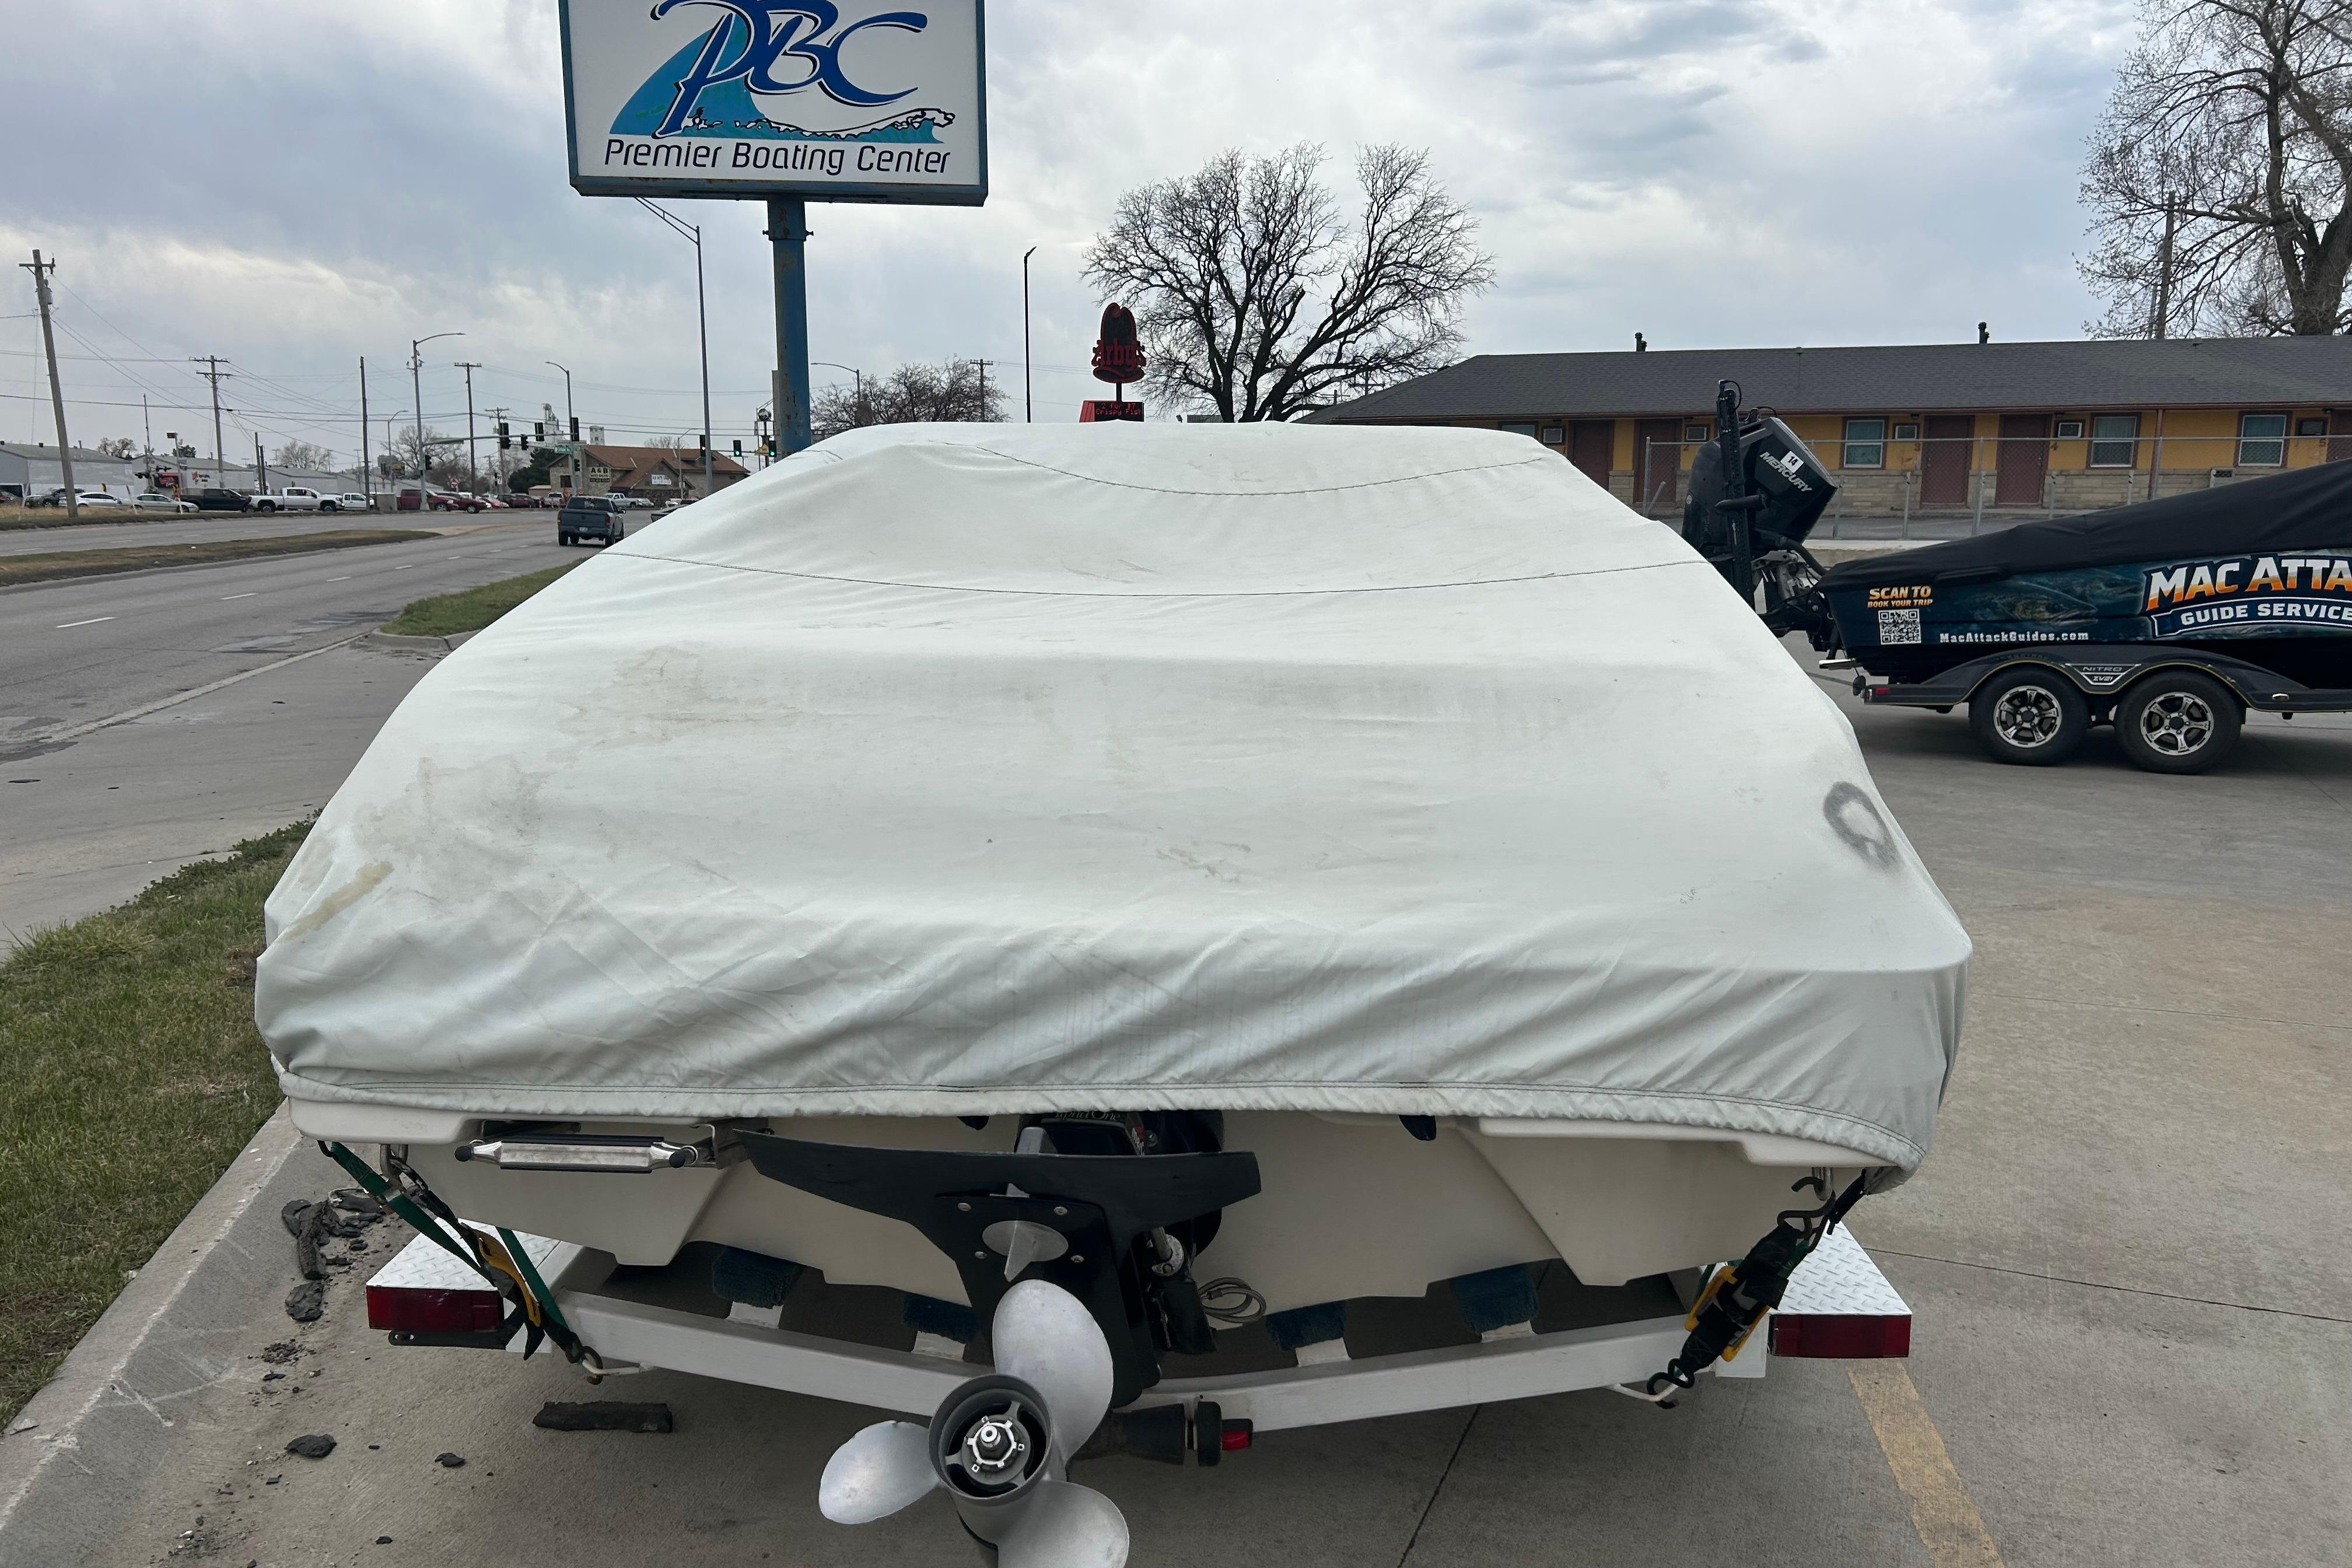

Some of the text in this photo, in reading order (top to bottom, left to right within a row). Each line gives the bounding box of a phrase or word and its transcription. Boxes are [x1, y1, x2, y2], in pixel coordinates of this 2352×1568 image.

[604, 139, 951, 175] Premier Boating Center
[1759, 452, 1813, 492] MERCURY
[1788, 456, 1798, 466] 14
[1869, 585, 1931, 600] SCAN TO
[2146, 556, 2352, 612] MAC ATTA
[2180, 603, 2352, 626] GUIDE SERVICE
[1940, 631, 2089, 643] MacAttackGuides.com
